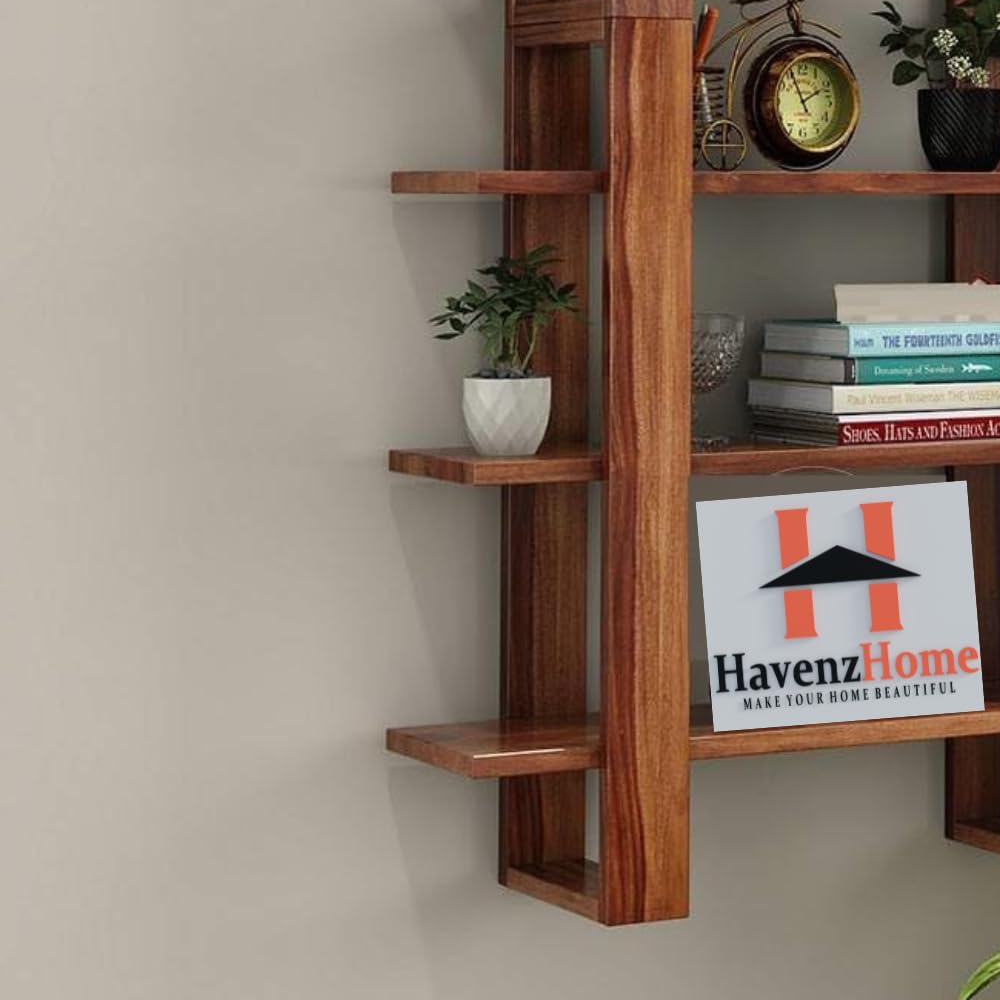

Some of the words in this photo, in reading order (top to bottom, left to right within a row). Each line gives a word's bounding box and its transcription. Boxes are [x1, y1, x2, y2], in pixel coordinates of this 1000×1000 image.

[881, 335, 901, 348] THE
[903, 333, 963, 348] FOURTEENTH
[947, 389, 966, 402] THE
[883, 422, 914, 442] HATS
[915, 424, 939, 440] AND
[939, 420, 984, 439] FASHION
[713, 641, 981, 694] HavenzHome
[743, 691, 782, 711] MAKE
[786, 689, 825, 707] YOUR
[829, 687, 870, 705] HOME
[875, 680, 957, 700] BEAUTIFUL
